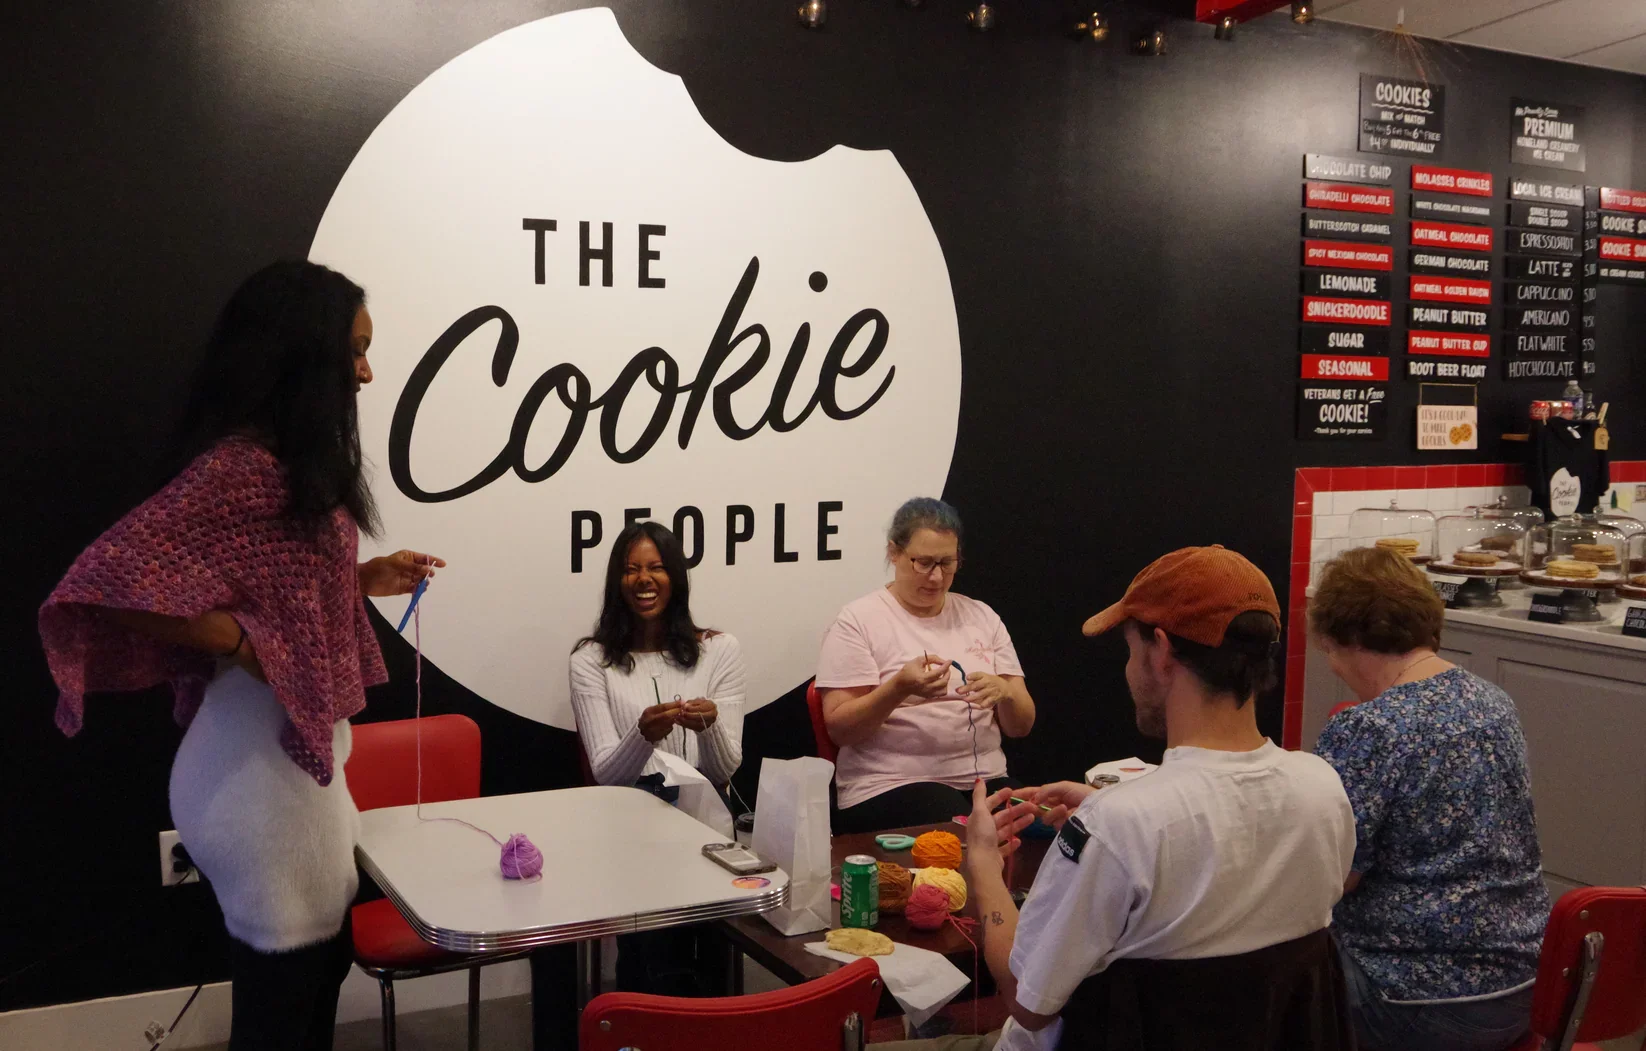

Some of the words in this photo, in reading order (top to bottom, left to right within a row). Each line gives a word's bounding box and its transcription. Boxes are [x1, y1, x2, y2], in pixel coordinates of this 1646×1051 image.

[1375, 82, 1431, 108] COOKIES
[1380, 110, 1394, 121] MIX
[1404, 113, 1425, 125] MATCH
[1386, 125, 1391, 135] 5
[1424, 131, 1441, 141] FREE
[1524, 117, 1574, 140] PREMIUM
[1390, 139, 1435, 153] INDIVIDUALLY
[1533, 150, 1543, 159] ICE
[1544, 150, 1564, 162] CREAM
[1369, 165, 1391, 180] CHIP
[1415, 172, 1454, 188] MOLASSES
[1456, 177, 1490, 191] CRINKLES
[1513, 182, 1537, 196] LOCAL
[1540, 185, 1552, 198] ICE
[1555, 187, 1581, 200] CREAM
[1351, 194, 1391, 206] CHOCOLATE
[1433, 202, 1460, 213] CHOCOLATE
[1309, 219, 1360, 232] BUTTERSCOTCH
[1361, 224, 1390, 234] CARAMEL
[1602, 216, 1635, 233] COOKIE
[1414, 228, 1448, 242] OATMEAL
[1450, 232, 1490, 245] CHOCOLATE
[522, 218, 666, 288] THE
[1308, 248, 1326, 258] SPICY
[1356, 252, 1389, 263] CHOCOLATE
[1602, 242, 1632, 256] COOKIE
[1414, 254, 1446, 268] GERMAN
[1447, 257, 1489, 272] CHOCOLATE
[1528, 260, 1560, 276] LATTE
[1320, 274, 1377, 293] LEMONADE
[1414, 283, 1442, 294] OATMEAL
[1518, 285, 1573, 300] CAPPUCCINO
[1307, 302, 1388, 320] SNICKERDOODLE
[1413, 307, 1449, 324] PEANUT
[1451, 310, 1487, 326] BUTTER
[1522, 310, 1570, 326] AMERICANO
[1328, 332, 1364, 348] SUGAR
[1412, 336, 1440, 348] PEANUT
[1442, 338, 1471, 350] BUTTER
[1473, 340, 1487, 351] CUP
[1318, 359, 1374, 376] SEASONAL
[1410, 362, 1435, 375] ROOT
[1437, 363, 1459, 377] BEER
[1461, 364, 1486, 378] FLOAT
[389, 256, 895, 503] Cookie
[1304, 388, 1342, 400] VETERANS
[1342, 389, 1357, 400] GET
[1359, 390, 1365, 400] A
[1320, 404, 1369, 423] COOKIE!
[571, 501, 843, 573] POPLE
[842, 872, 854, 918] Sprite
